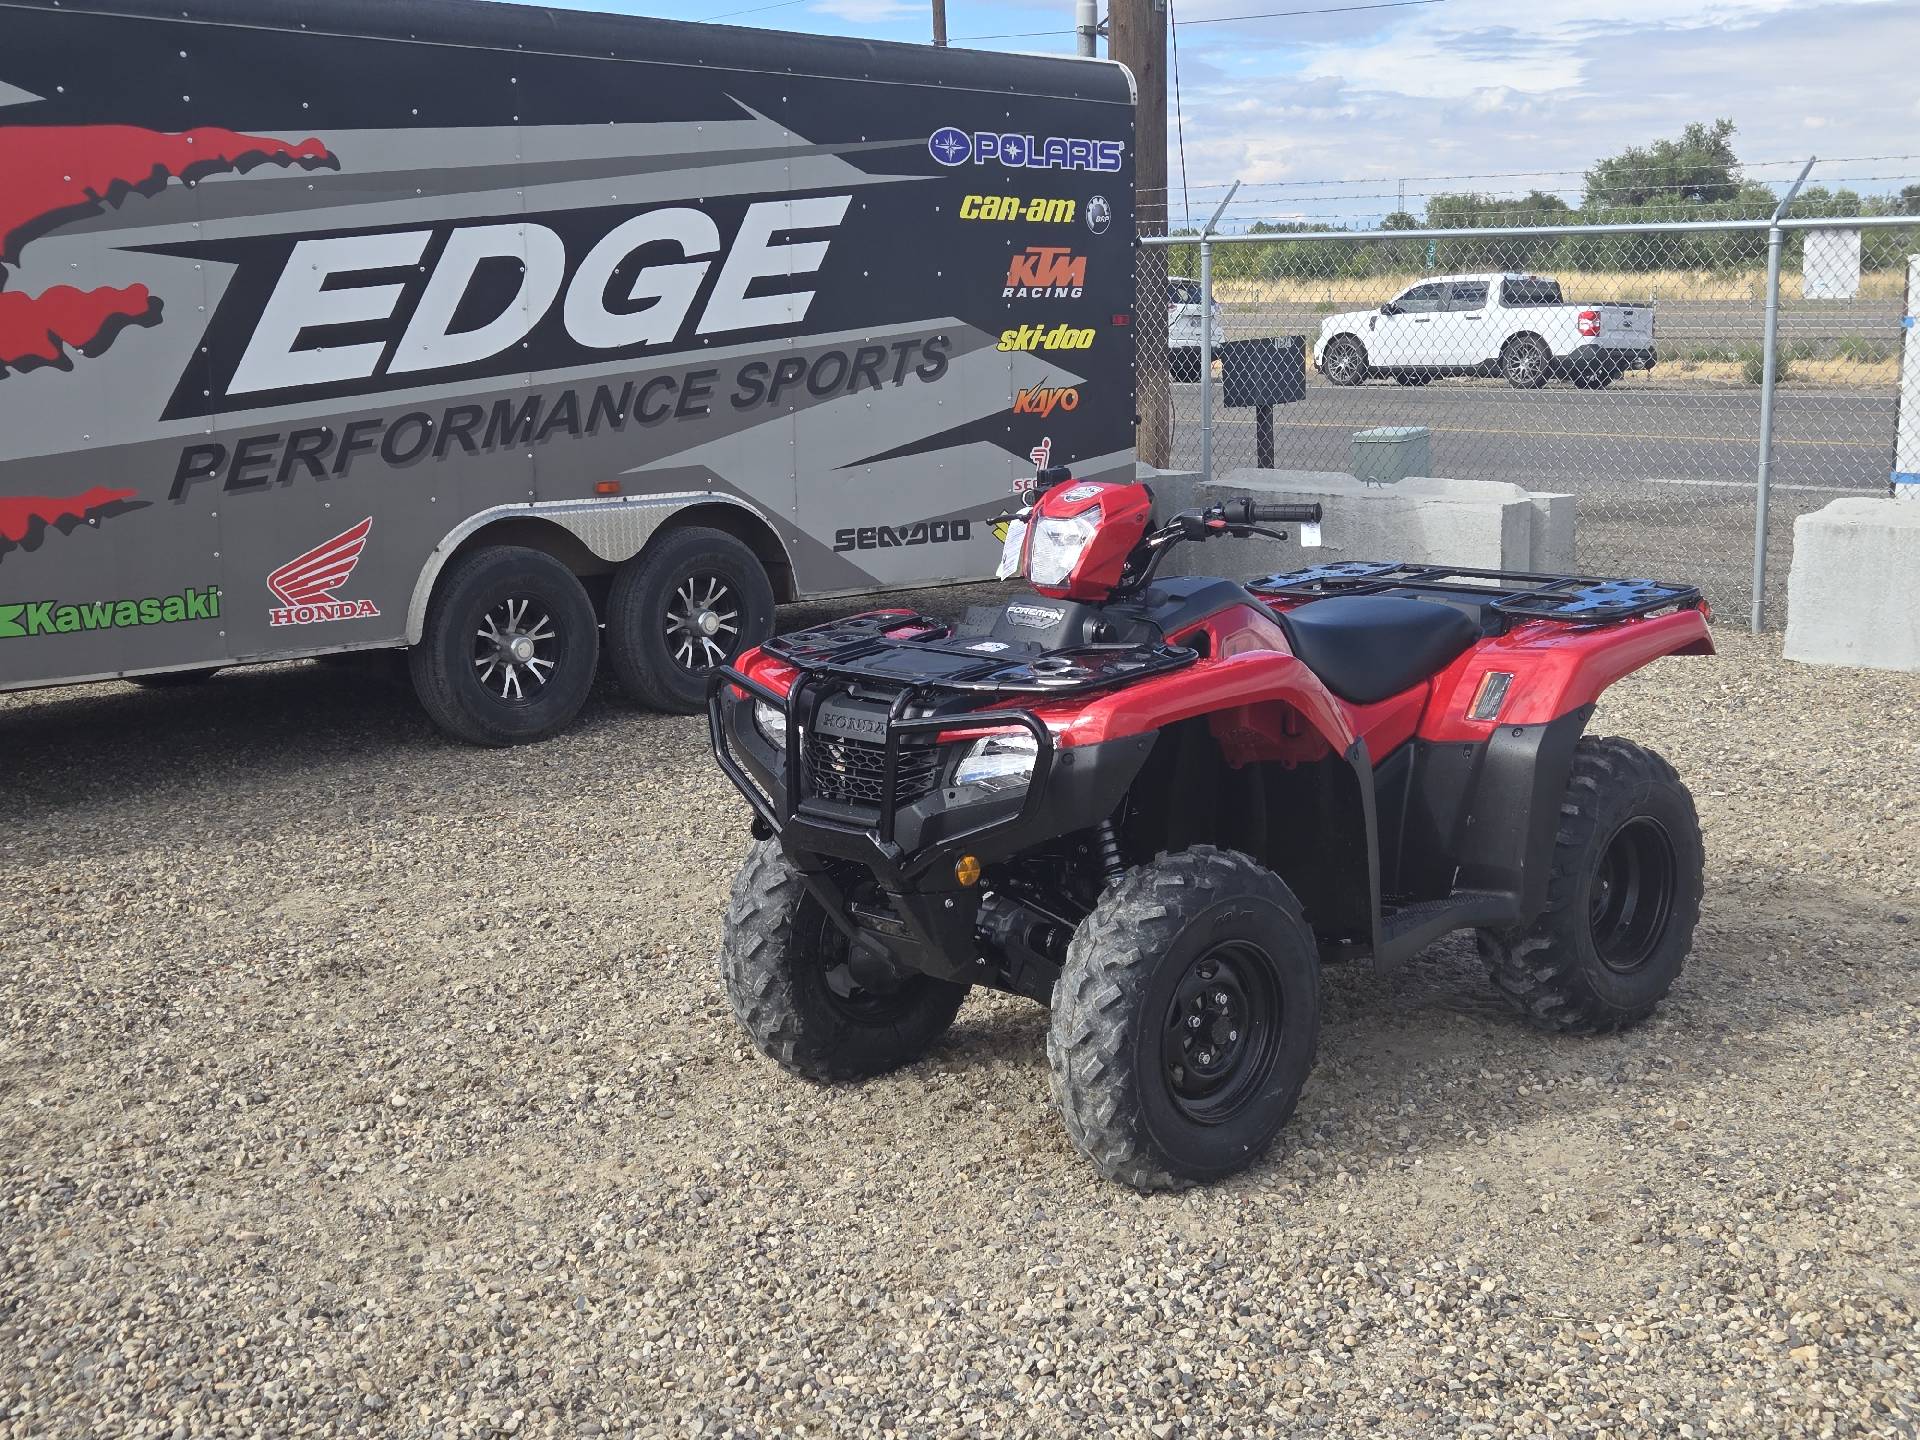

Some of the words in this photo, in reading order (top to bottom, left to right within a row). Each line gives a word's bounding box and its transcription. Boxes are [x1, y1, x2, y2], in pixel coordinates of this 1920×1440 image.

[974, 132, 1122, 172] POLARIS
[959, 195, 1076, 223] can-am
[1006, 247, 1087, 286] KTM
[226, 194, 852, 395] EDGE
[1002, 287, 1083, 298] RACING
[997, 323, 1096, 351] ski-doo
[1013, 378, 1079, 418] KAYO
[167, 369, 719, 502] PERFORMANCE
[730, 335, 952, 408] SPORTS
[24, 585, 218, 635] Kawasaki
[270, 600, 380, 626] HONDA
[1007, 606, 1066, 620] FOREMAN
[823, 713, 886, 735] HONDA
